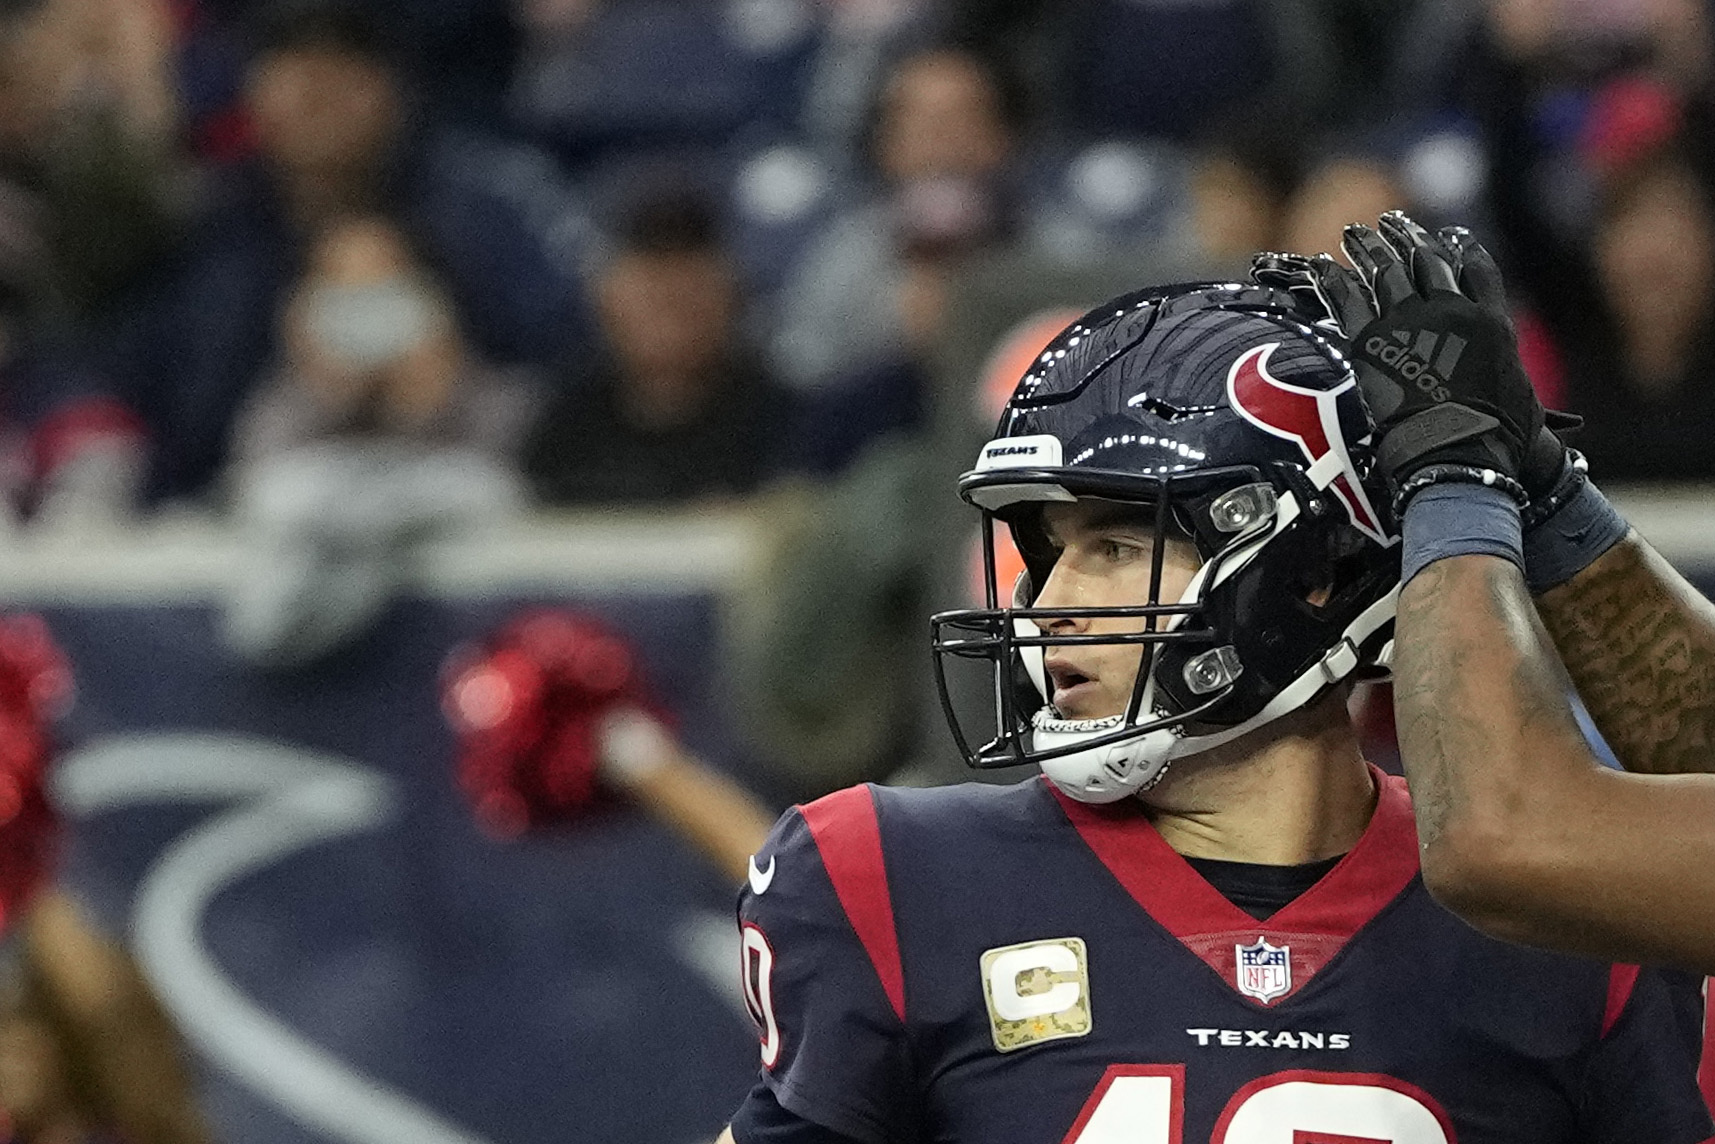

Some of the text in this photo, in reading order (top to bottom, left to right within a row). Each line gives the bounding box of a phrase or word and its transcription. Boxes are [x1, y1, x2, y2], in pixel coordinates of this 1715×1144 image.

[1365, 336, 1452, 402] adidas
[986, 446, 1039, 459] TEXANS
[990, 944, 1080, 1021] C
[1247, 967, 1282, 991] NFL
[1186, 1028, 1351, 1049] TEXANS
